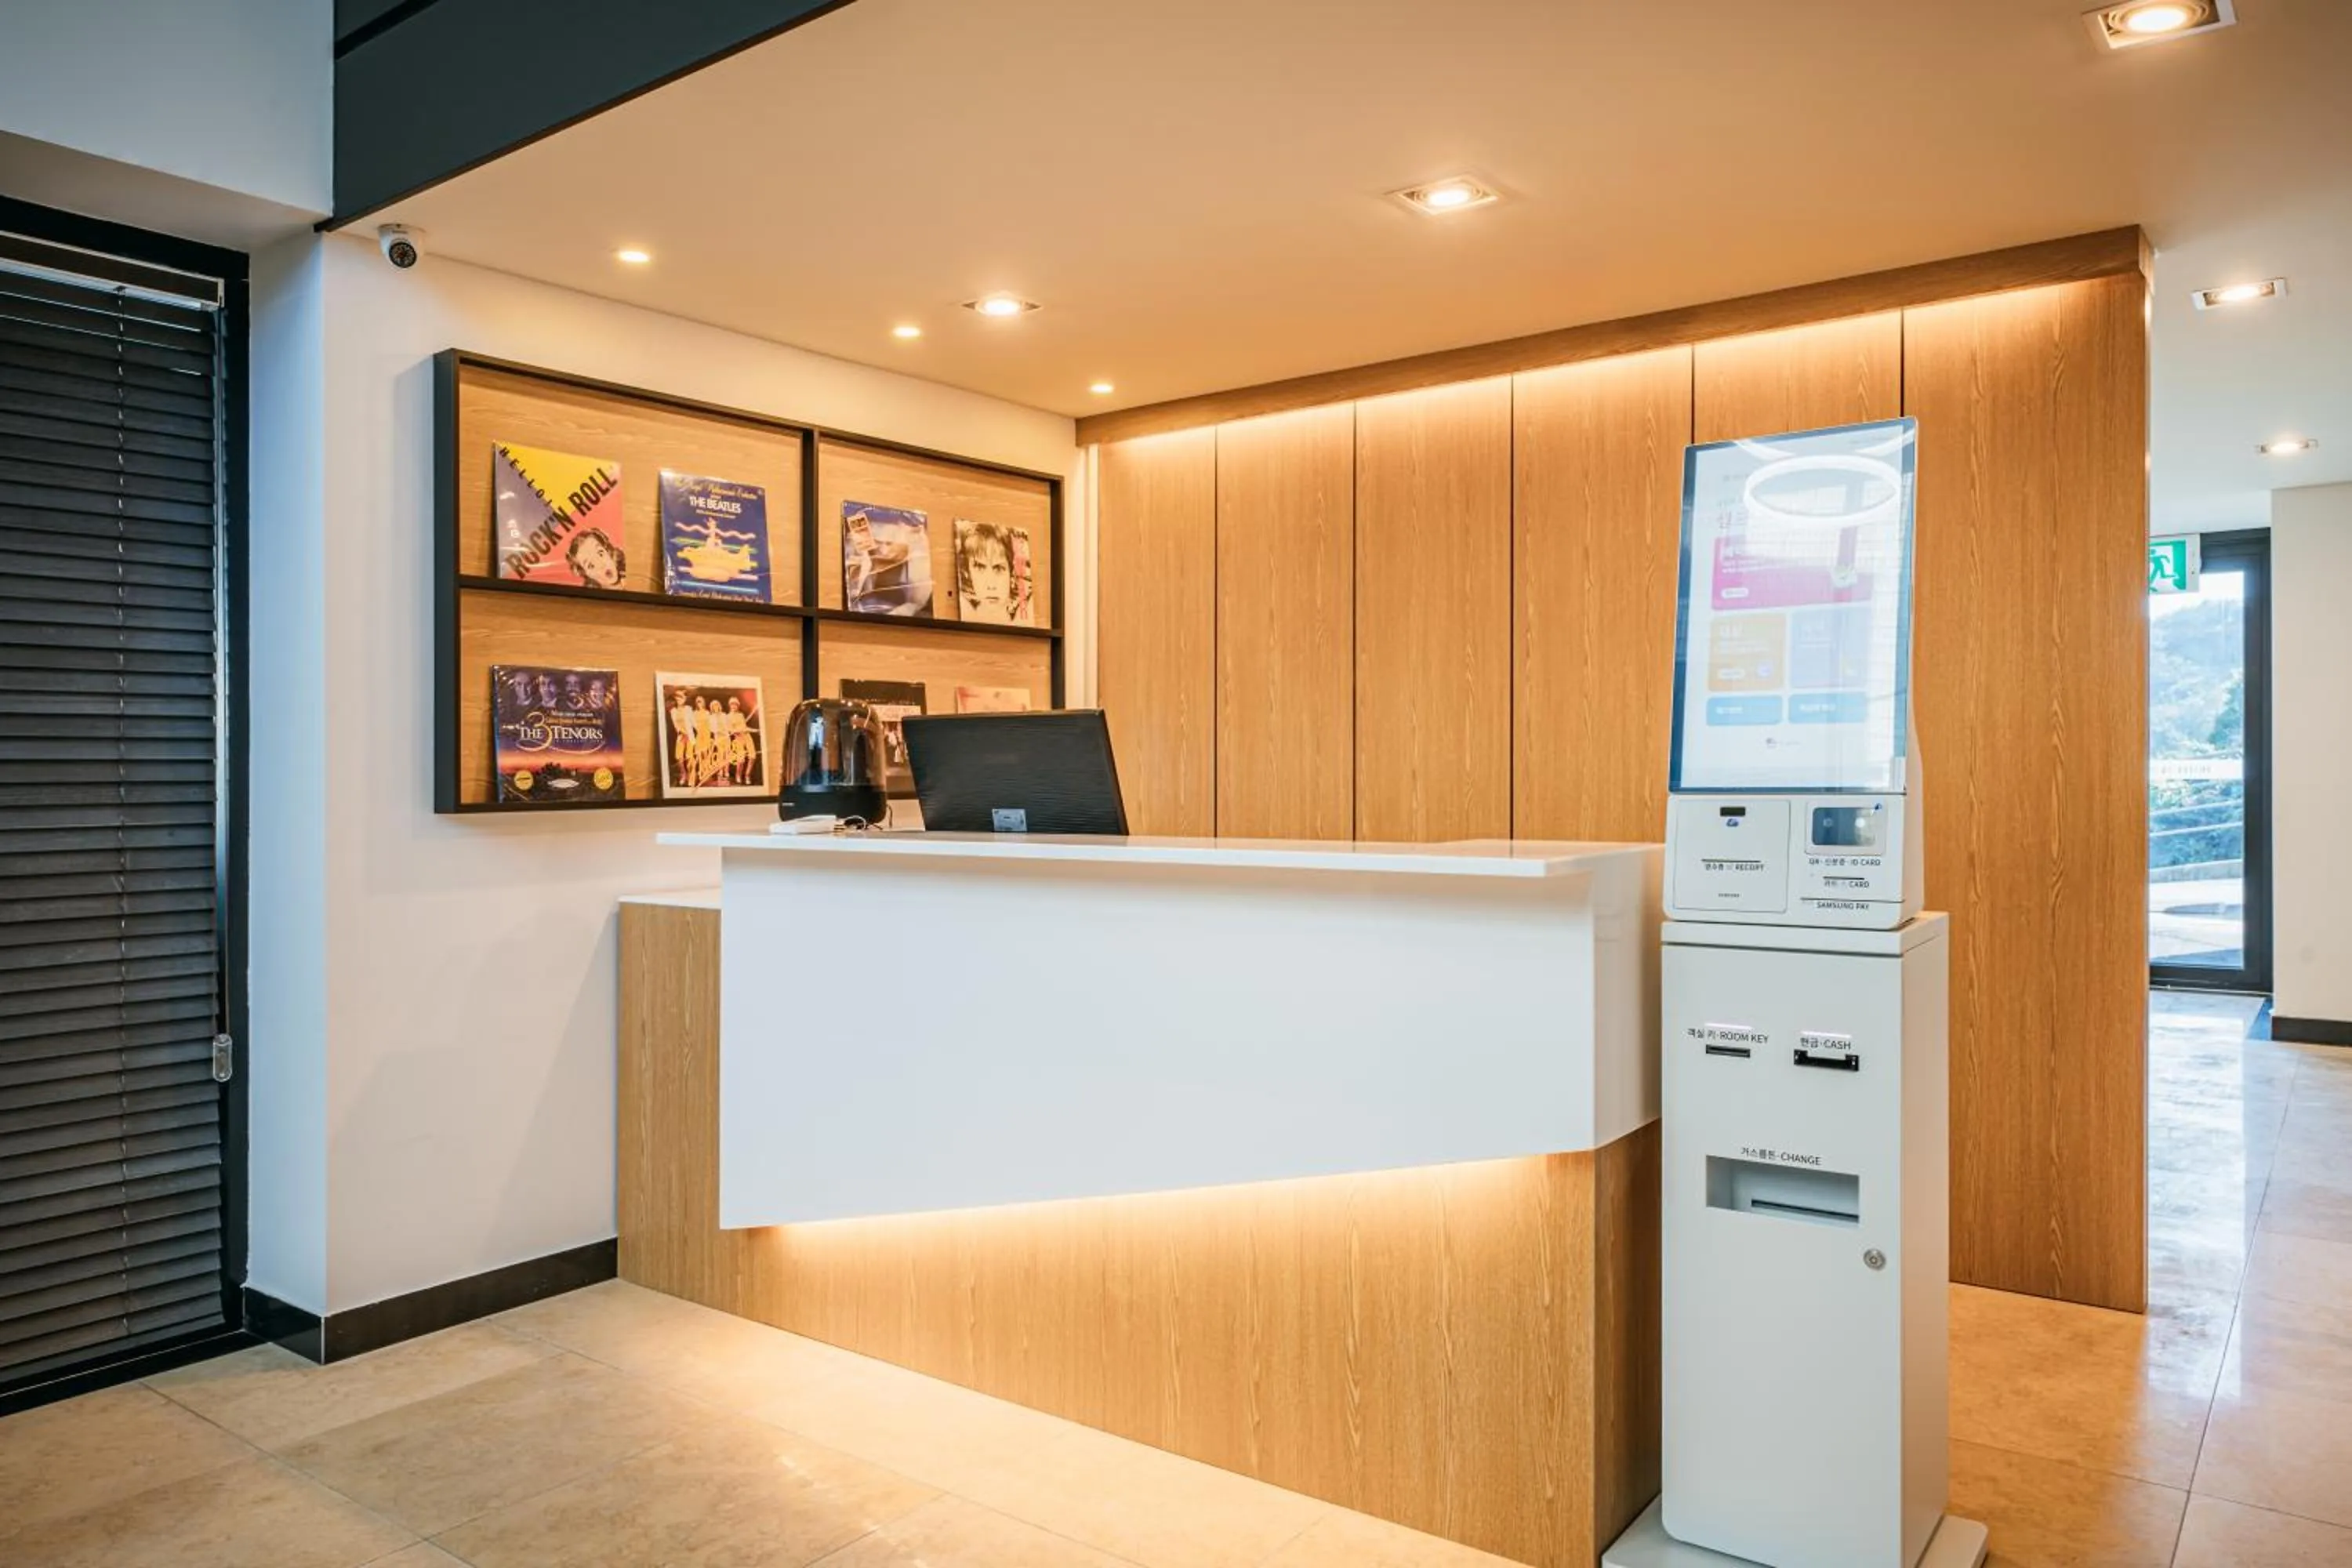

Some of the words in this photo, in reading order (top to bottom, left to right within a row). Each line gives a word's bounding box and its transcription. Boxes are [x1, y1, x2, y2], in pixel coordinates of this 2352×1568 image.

[568, 468, 618, 517] ROLL
[689, 495, 706, 509] THE
[706, 499, 742, 514] BEATLES
[520, 726, 543, 739] THE
[550, 725, 603, 739] TENORS
[1751, 1034, 1769, 1044] KEY
